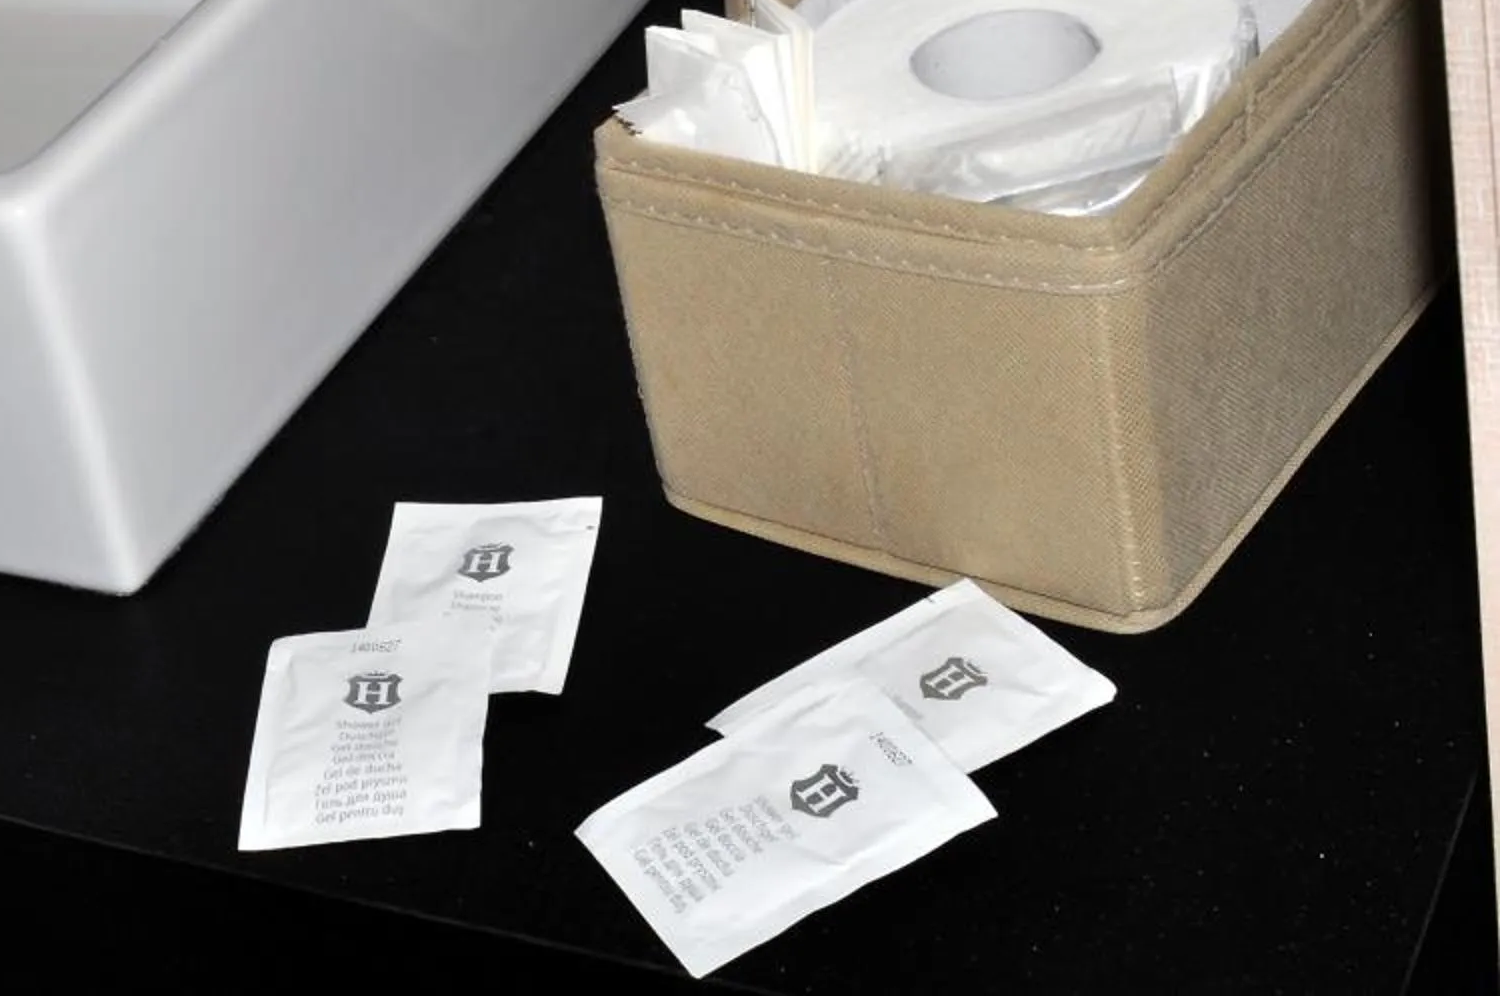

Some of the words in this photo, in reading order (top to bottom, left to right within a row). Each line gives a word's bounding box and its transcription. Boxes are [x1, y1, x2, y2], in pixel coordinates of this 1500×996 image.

[323, 767, 343, 781] Gel
[335, 778, 358, 794] pod
[314, 810, 337, 824] Gel
